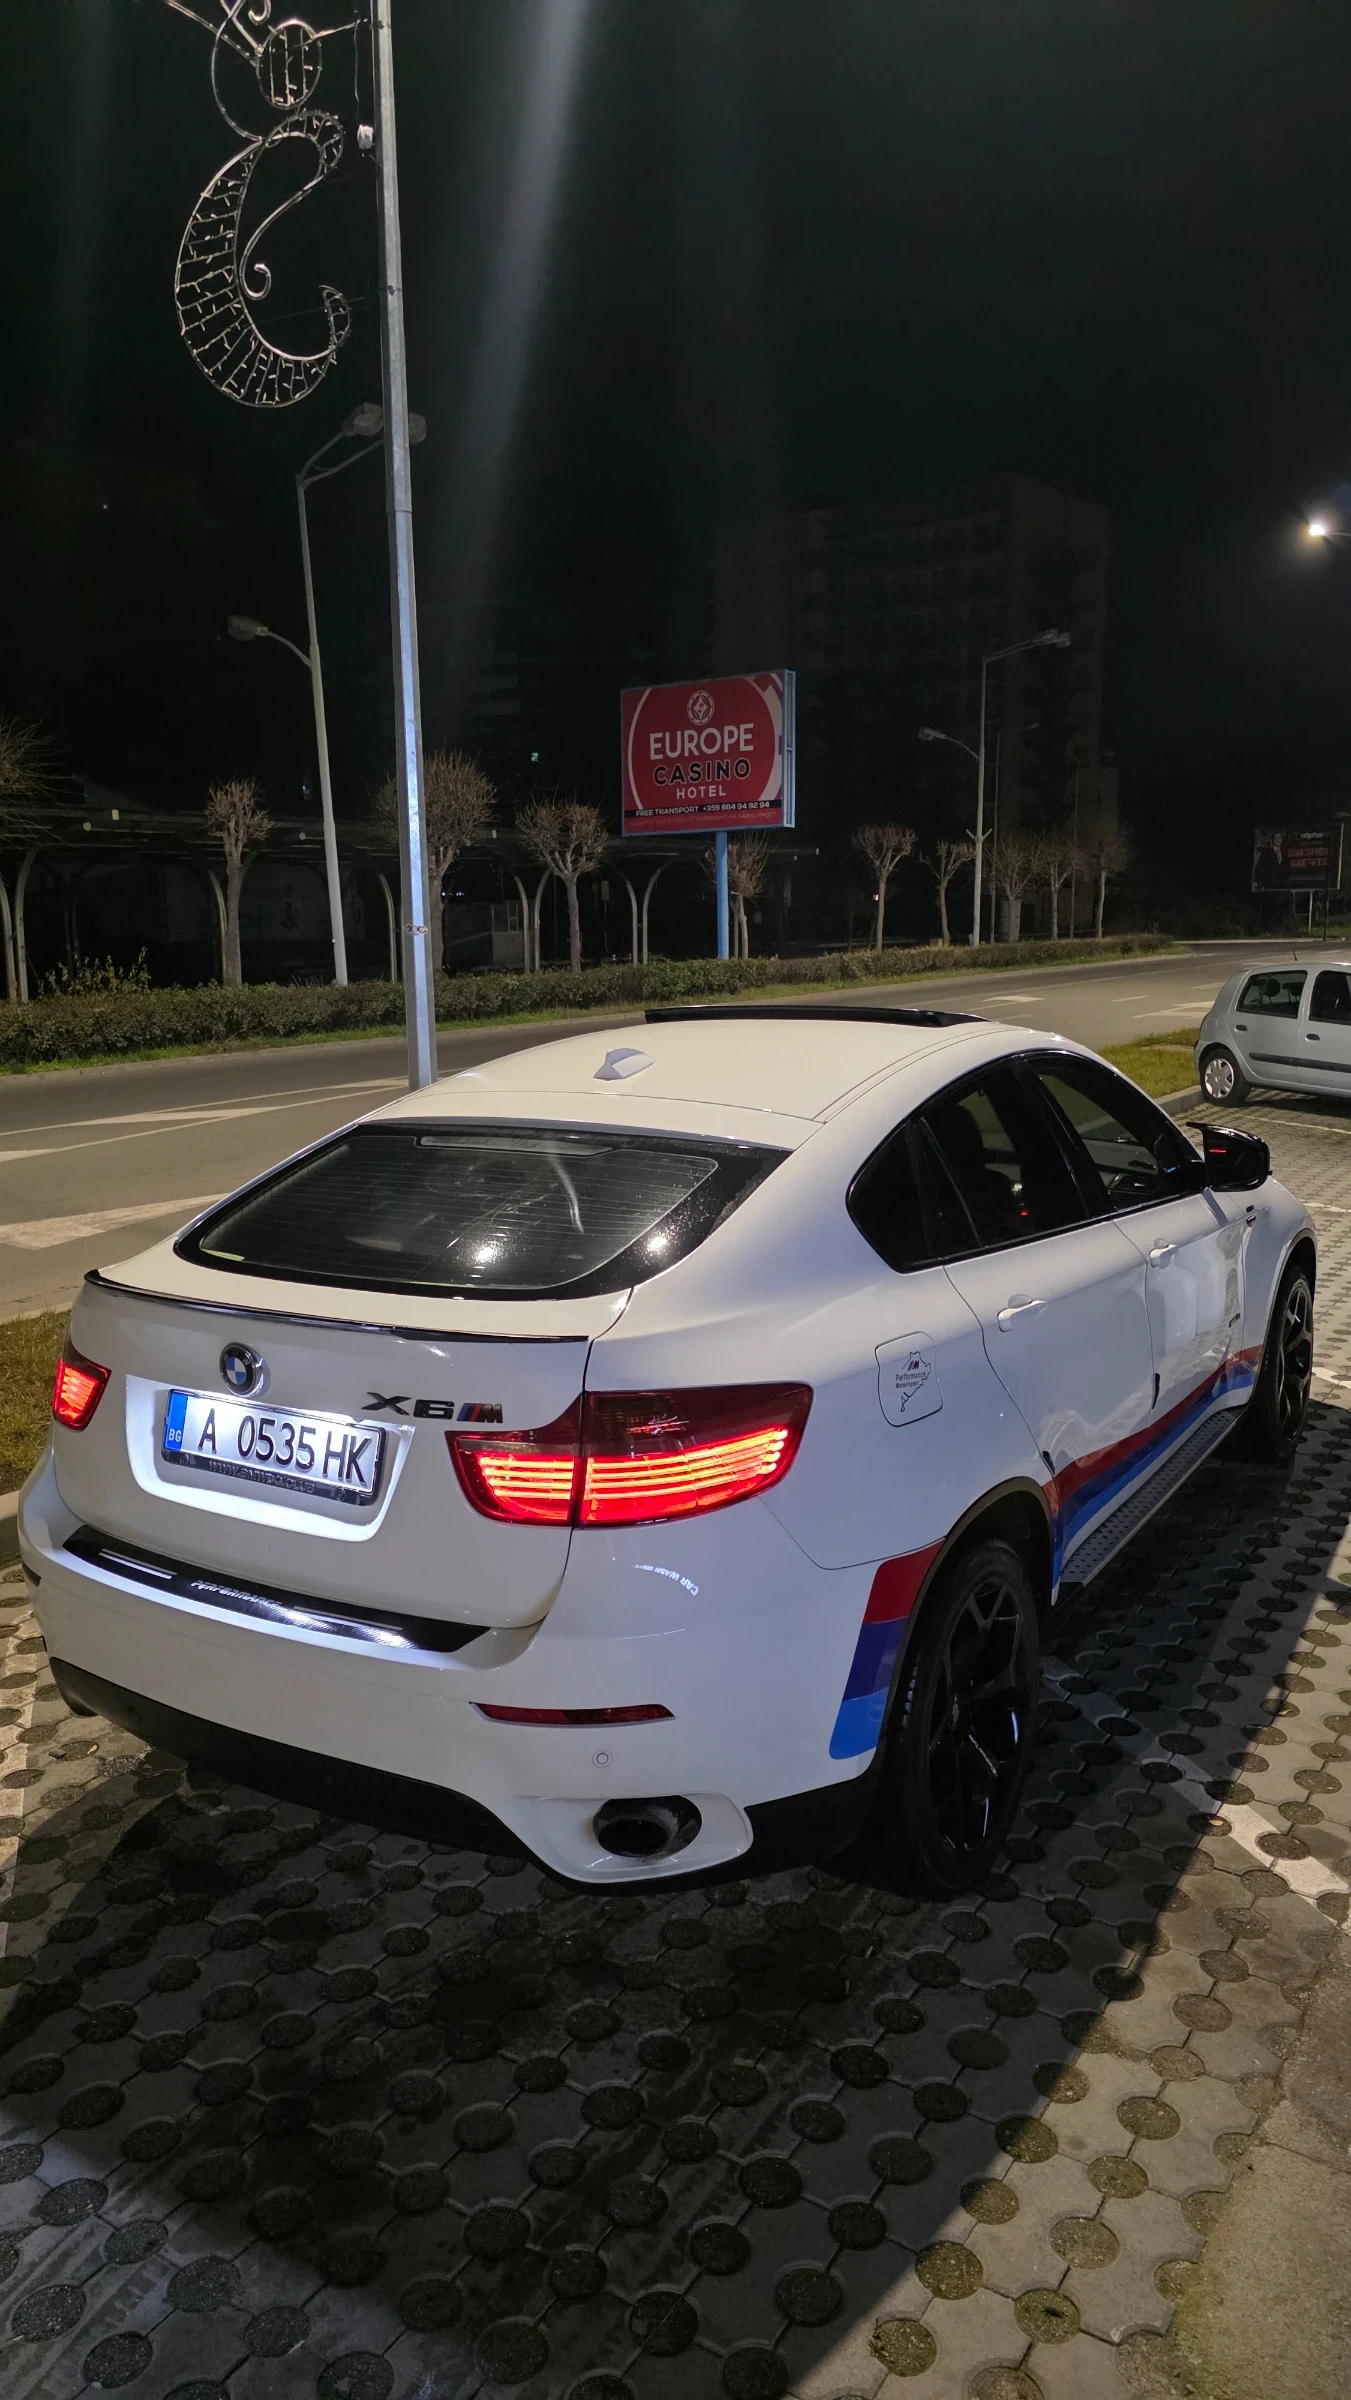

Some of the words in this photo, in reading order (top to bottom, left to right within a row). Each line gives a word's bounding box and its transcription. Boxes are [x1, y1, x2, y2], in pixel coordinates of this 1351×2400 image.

[650, 723, 754, 760] EUROPE
[653, 758, 750, 786] CASINO
[676, 785, 727, 800] HOTEL
[635, 809, 654, 817] FREE
[654, 805, 700, 815] TRANSPORT
[702, 804, 720, 812] +359
[721, 803, 736, 811] 884
[737, 802, 748, 810] 94
[759, 801, 770, 809] 94
[895, 1371, 926, 1382] Performance
[895, 1380, 920, 1389] Motorsport
[361, 1391, 455, 1420] X6
[168, 1428, 182, 1443] BG
[198, 1408, 217, 1454] A
[237, 1415, 316, 1471] 0535
[322, 1430, 372, 1485] HK
[654, 1567, 680, 1581] WASH
[190, 1580, 283, 1607] PERFORMANCE
[680, 1576, 699, 1596] CAR
